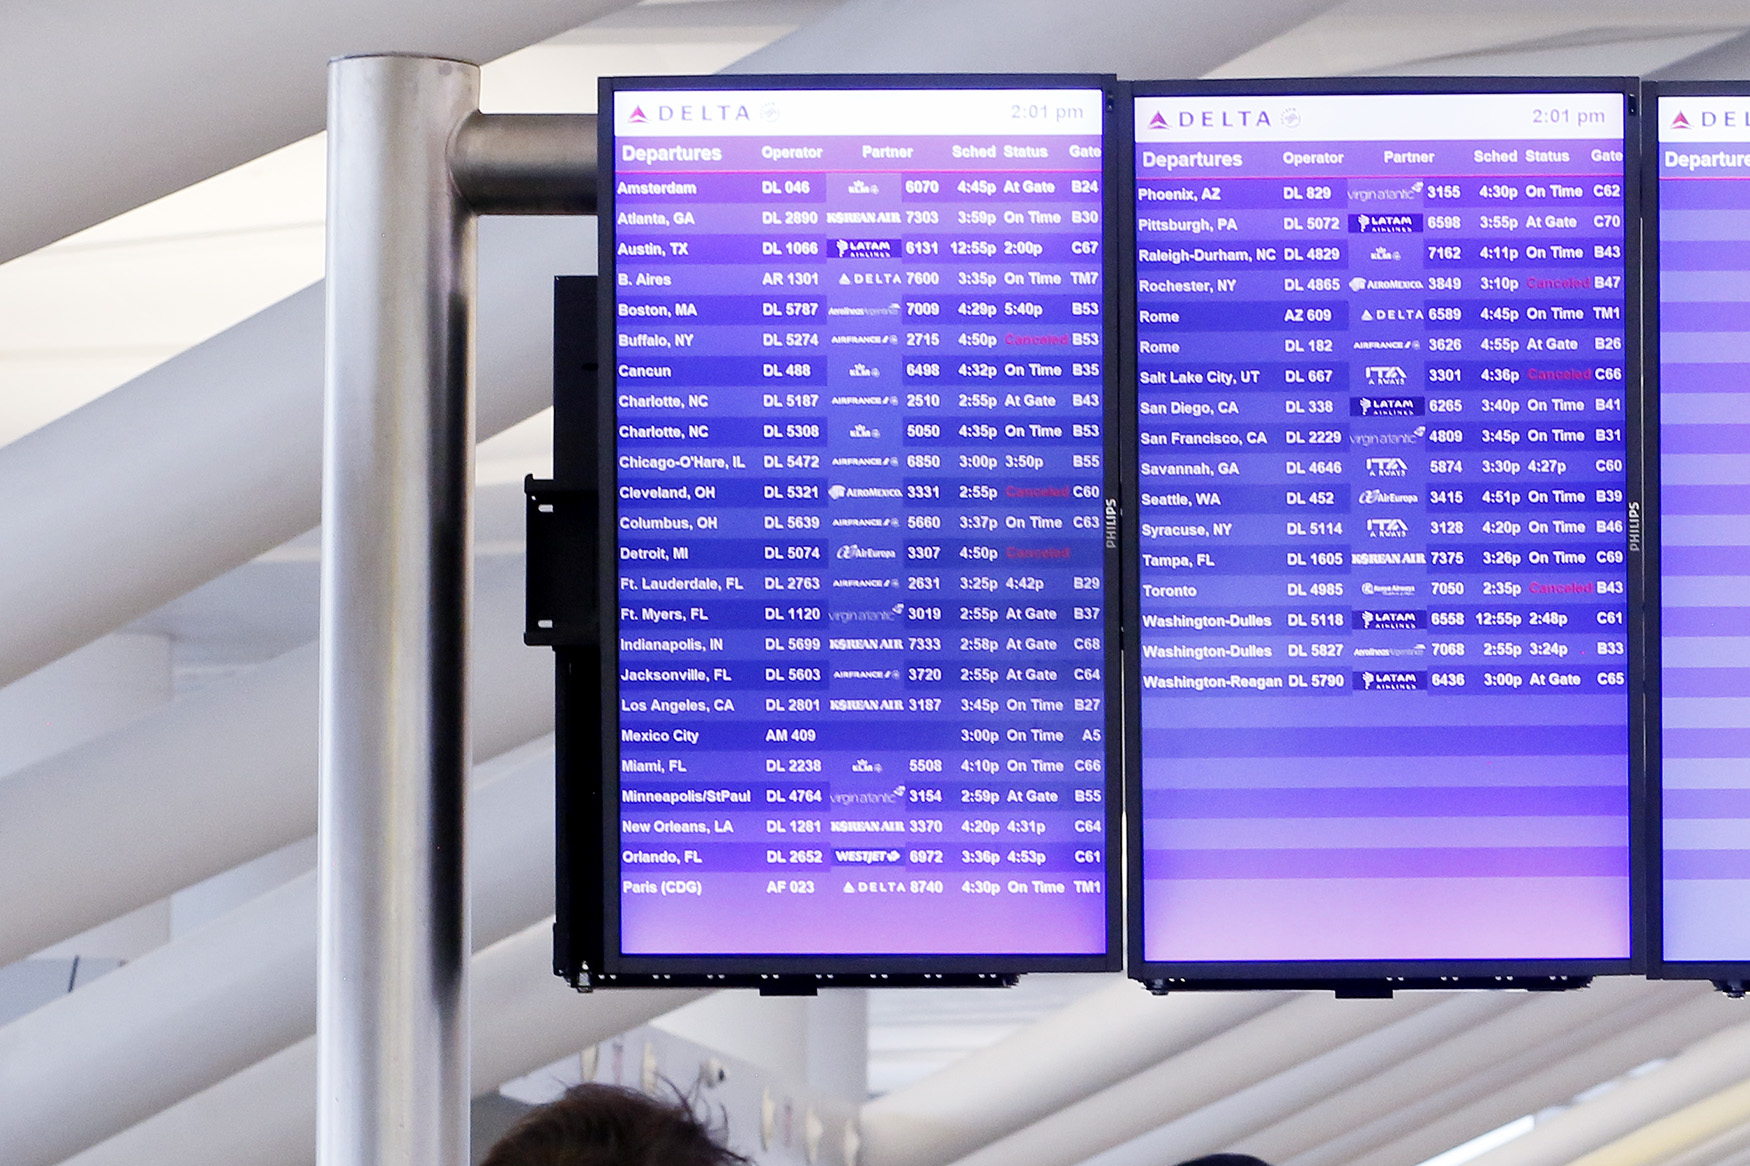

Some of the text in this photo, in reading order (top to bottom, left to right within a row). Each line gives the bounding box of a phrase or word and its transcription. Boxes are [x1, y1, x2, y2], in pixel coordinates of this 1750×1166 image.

[659, 106, 749, 120] DELTA
[1013, 105, 1082, 121] 2:01 pm
[1179, 111, 1271, 127] DELTA
[1533, 109, 1605, 126] 2:01 pm
[622, 145, 1101, 165] Departures Operator Partner Sched Status Gate
[1143, 149, 1621, 171] Departures Operator Partner Sched Status Gate
[617, 181, 697, 194] Amsterdam
[762, 181, 782, 194] DL
[785, 181, 810, 194] 046
[906, 180, 939, 193] 6070
[957, 180, 997, 195] 4:45p
[1003, 180, 1020, 193] At
[1023, 180, 1055, 193] Gate
[1072, 180, 1099, 193] B24
[1138, 218, 1213, 235] Pittsburgh,
[1218, 218, 1238, 230] PA
[1284, 217, 1303, 230] DL
[1307, 217, 1340, 230] 5072
[1371, 216, 1412, 225] LATAM
[1428, 216, 1461, 229] 6598
[1480, 216, 1518, 231] 3:55p
[1526, 215, 1542, 228] At
[1545, 215, 1577, 228] Gate
[1594, 215, 1621, 227] C70
[618, 271, 1100, 287] B. Aires AR 1301 DELTA 7600 3:35p On Time TM7
[1140, 307, 1619, 323] Rome AZ 609 DELTA 6589 4:45p On Time TM1
[619, 456, 729, 472] Chicago-O'Hare,
[733, 455, 746, 468] IL
[764, 455, 783, 468] DL
[787, 455, 819, 468] 5472
[907, 455, 940, 467] 6850
[959, 455, 997, 470] 3:00p
[1005, 455, 1043, 470] 3:50p
[1073, 455, 1100, 467] B55
[1141, 493, 1192, 507] Seattle,
[1196, 493, 1221, 505] WA
[1287, 492, 1306, 504] DL
[1309, 492, 1334, 504] 452
[1431, 491, 1463, 503] 3415
[1482, 491, 1520, 505] 4:51p
[1528, 490, 1548, 502] On
[1552, 490, 1585, 502] Time
[1596, 490, 1622, 502] B39
[1105, 499, 1117, 549] PHILIPS
[1628, 502, 1640, 551] PHILIPS
[620, 547, 669, 561] Detroit,
[673, 547, 688, 559] MI
[765, 547, 784, 559] DL
[787, 547, 820, 559] 5074
[908, 547, 941, 559] 3307
[959, 547, 998, 561] 4:50p
[1007, 545, 1070, 558] Canceled
[620, 638, 1101, 655] Indianapolis, IN DL 5699 KOREAN AIR 7333 2:58p At Gate C68
[1143, 675, 1282, 690] Washington-Reagan
[1289, 675, 1308, 687] DL
[1311, 674, 1344, 687] 5790
[1376, 673, 1416, 682] LATAM
[1432, 673, 1465, 686] 6436
[1484, 673, 1522, 688] 3:00p
[1529, 673, 1546, 685] At
[1549, 673, 1581, 685] Gate
[1597, 672, 1624, 685] C65
[621, 729, 1101, 744] Mexico City AM 409 3:00p On Time A5
[622, 850, 1100, 865] Orlando, FL DL 2652 WESTJET 6972 3:36p 4:53p C61
